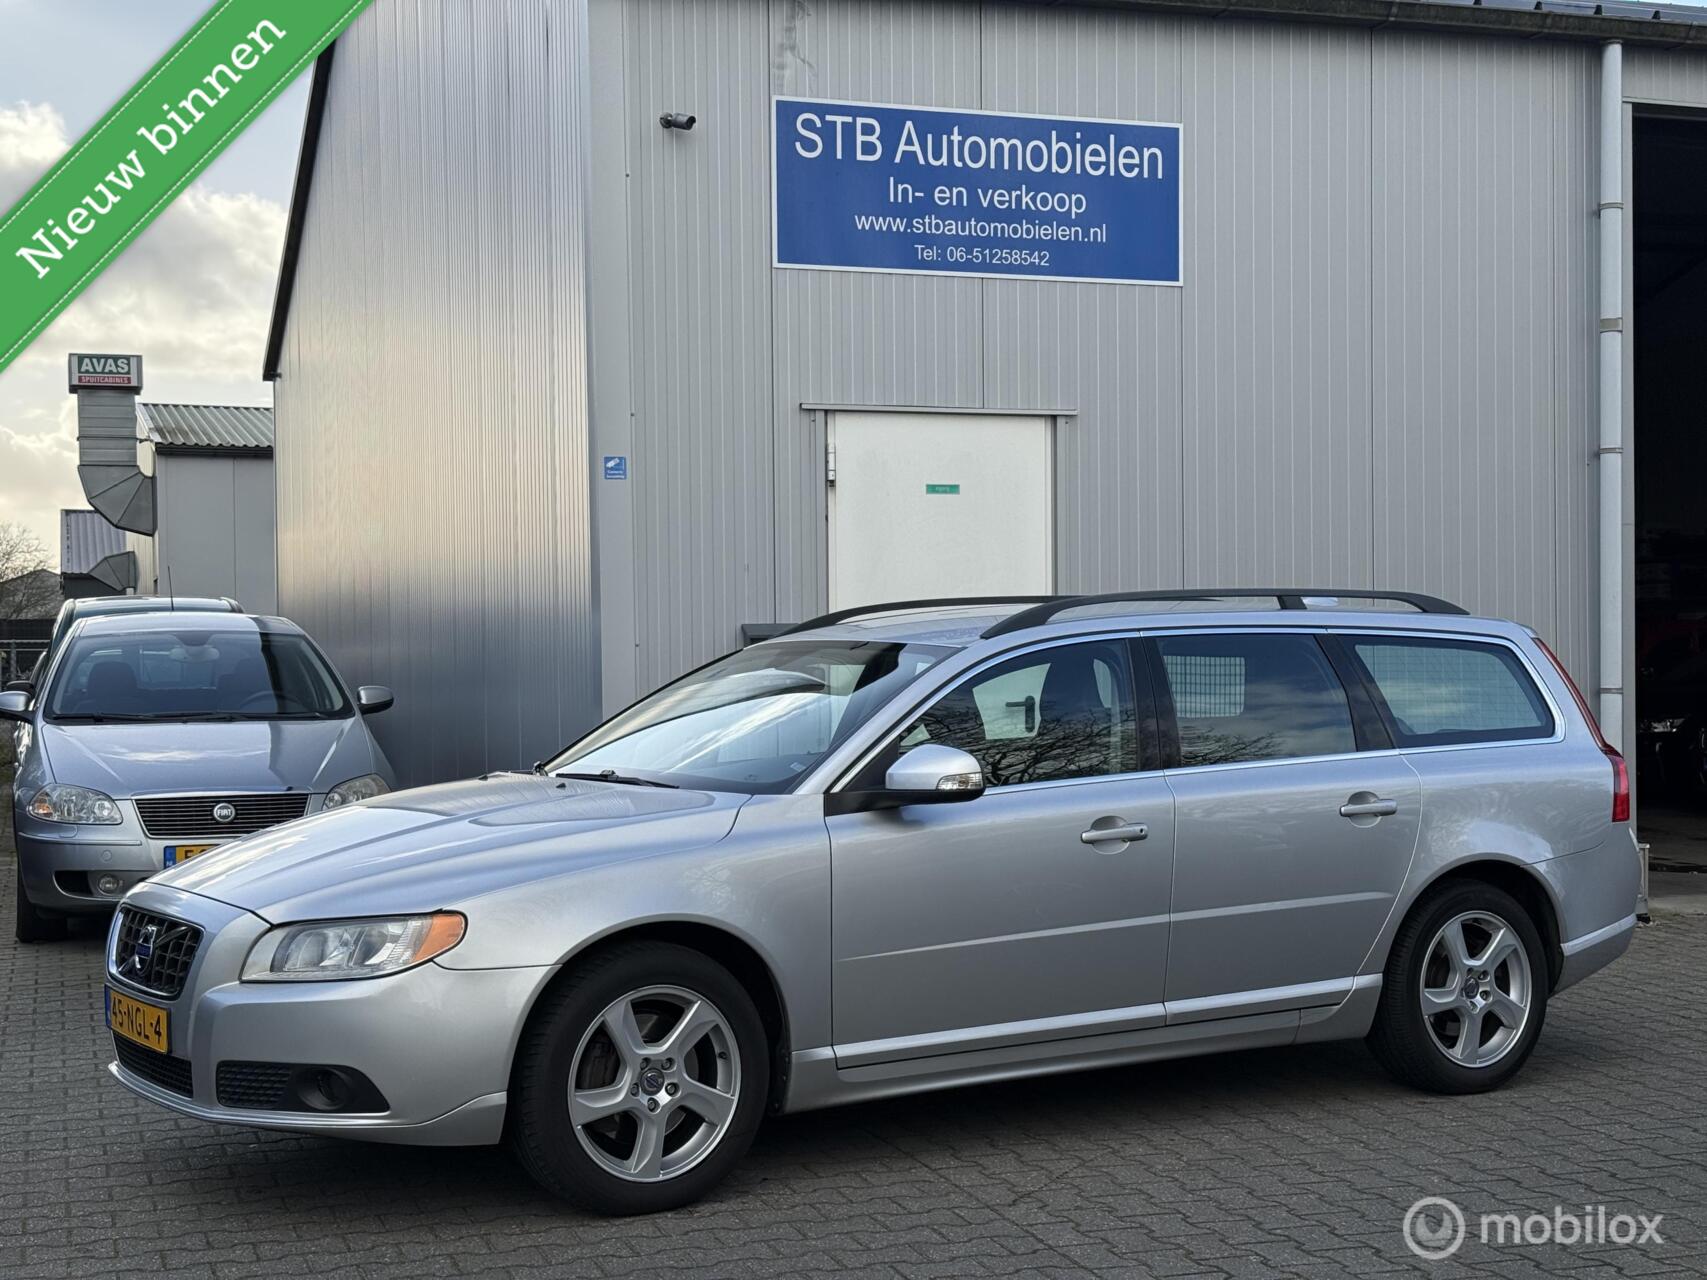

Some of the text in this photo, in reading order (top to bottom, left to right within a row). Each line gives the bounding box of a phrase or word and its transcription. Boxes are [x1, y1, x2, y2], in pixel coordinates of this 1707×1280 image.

[794, 112, 1164, 179] STB Automobielen
[888, 177, 1087, 218] In- en verkoop
[854, 215, 1107, 243] www.stbautomobielen.nl
[914, 245, 1050, 266] Tel: 06-51258542
[80, 358, 129, 373] AVAS
[217, 808, 232, 816] FIAT
[111, 996, 163, 1045] 45-NGL-4
